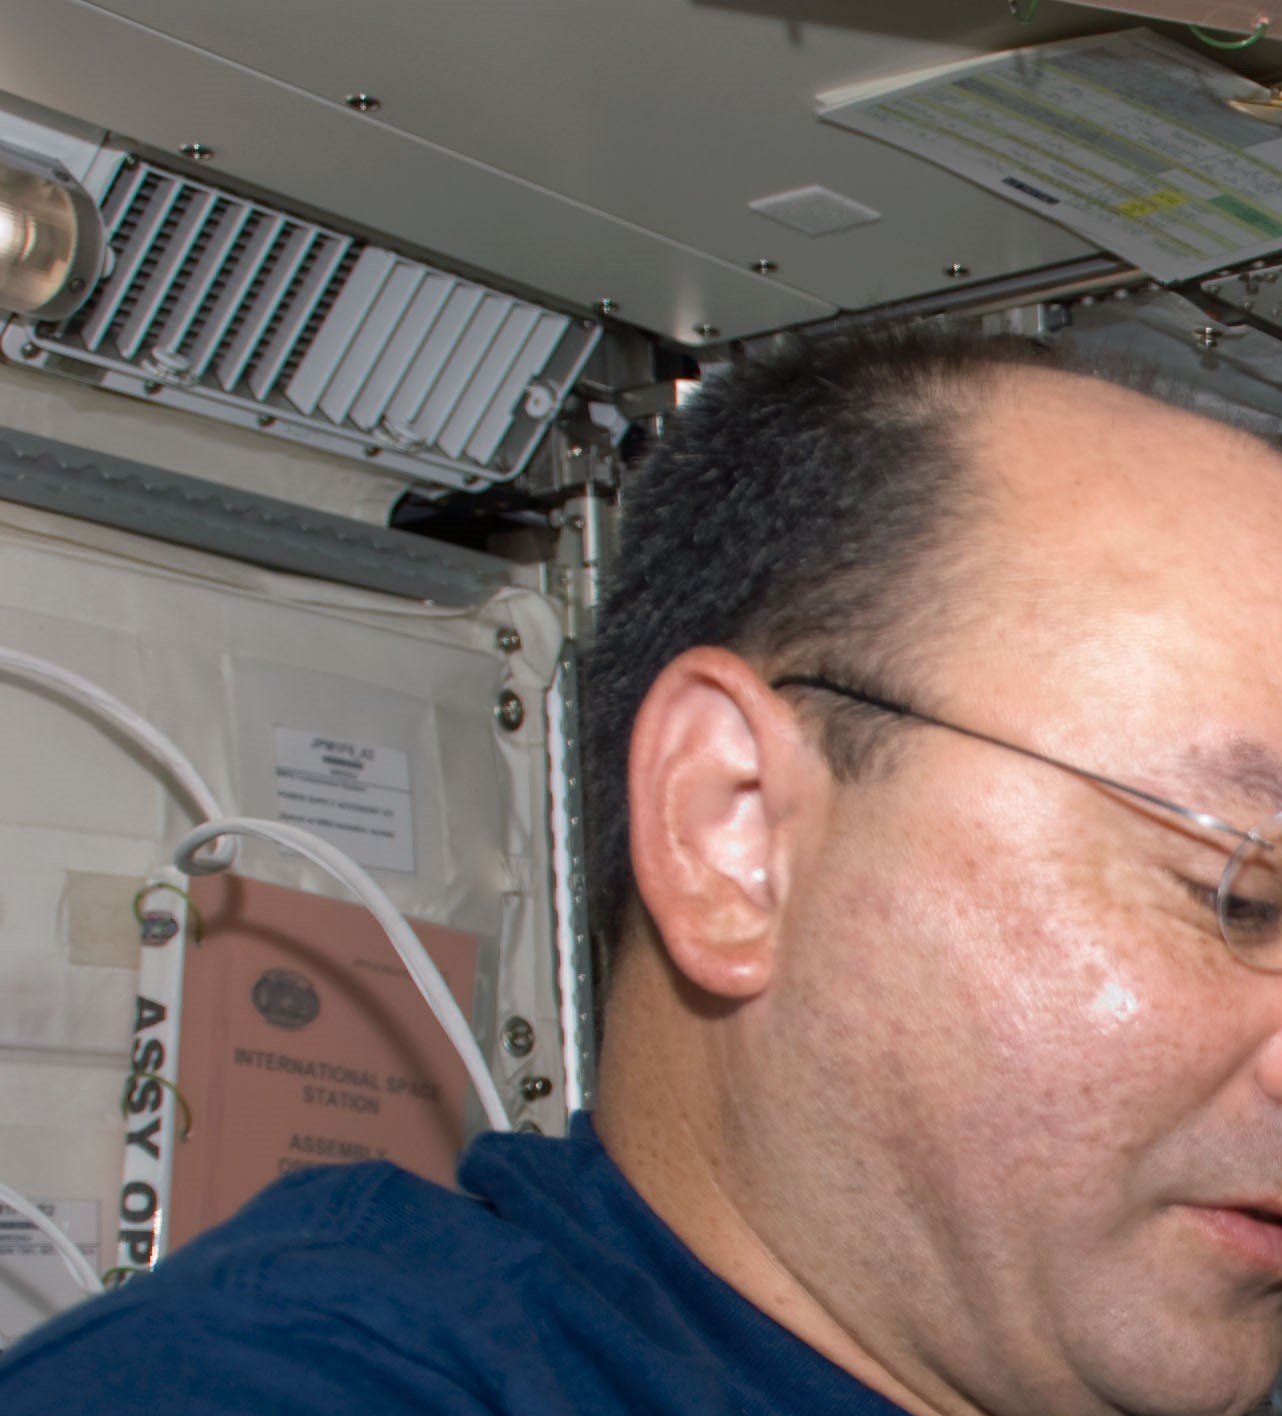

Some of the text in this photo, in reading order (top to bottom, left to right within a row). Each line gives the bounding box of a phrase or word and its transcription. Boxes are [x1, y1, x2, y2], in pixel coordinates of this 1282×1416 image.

[125, 994, 167, 1161] ASSY
[233, 1047, 442, 1104] INTERNATIONAL SPACE
[302, 1085, 380, 1115] STATION
[288, 1133, 388, 1160] ASSEMBLY
